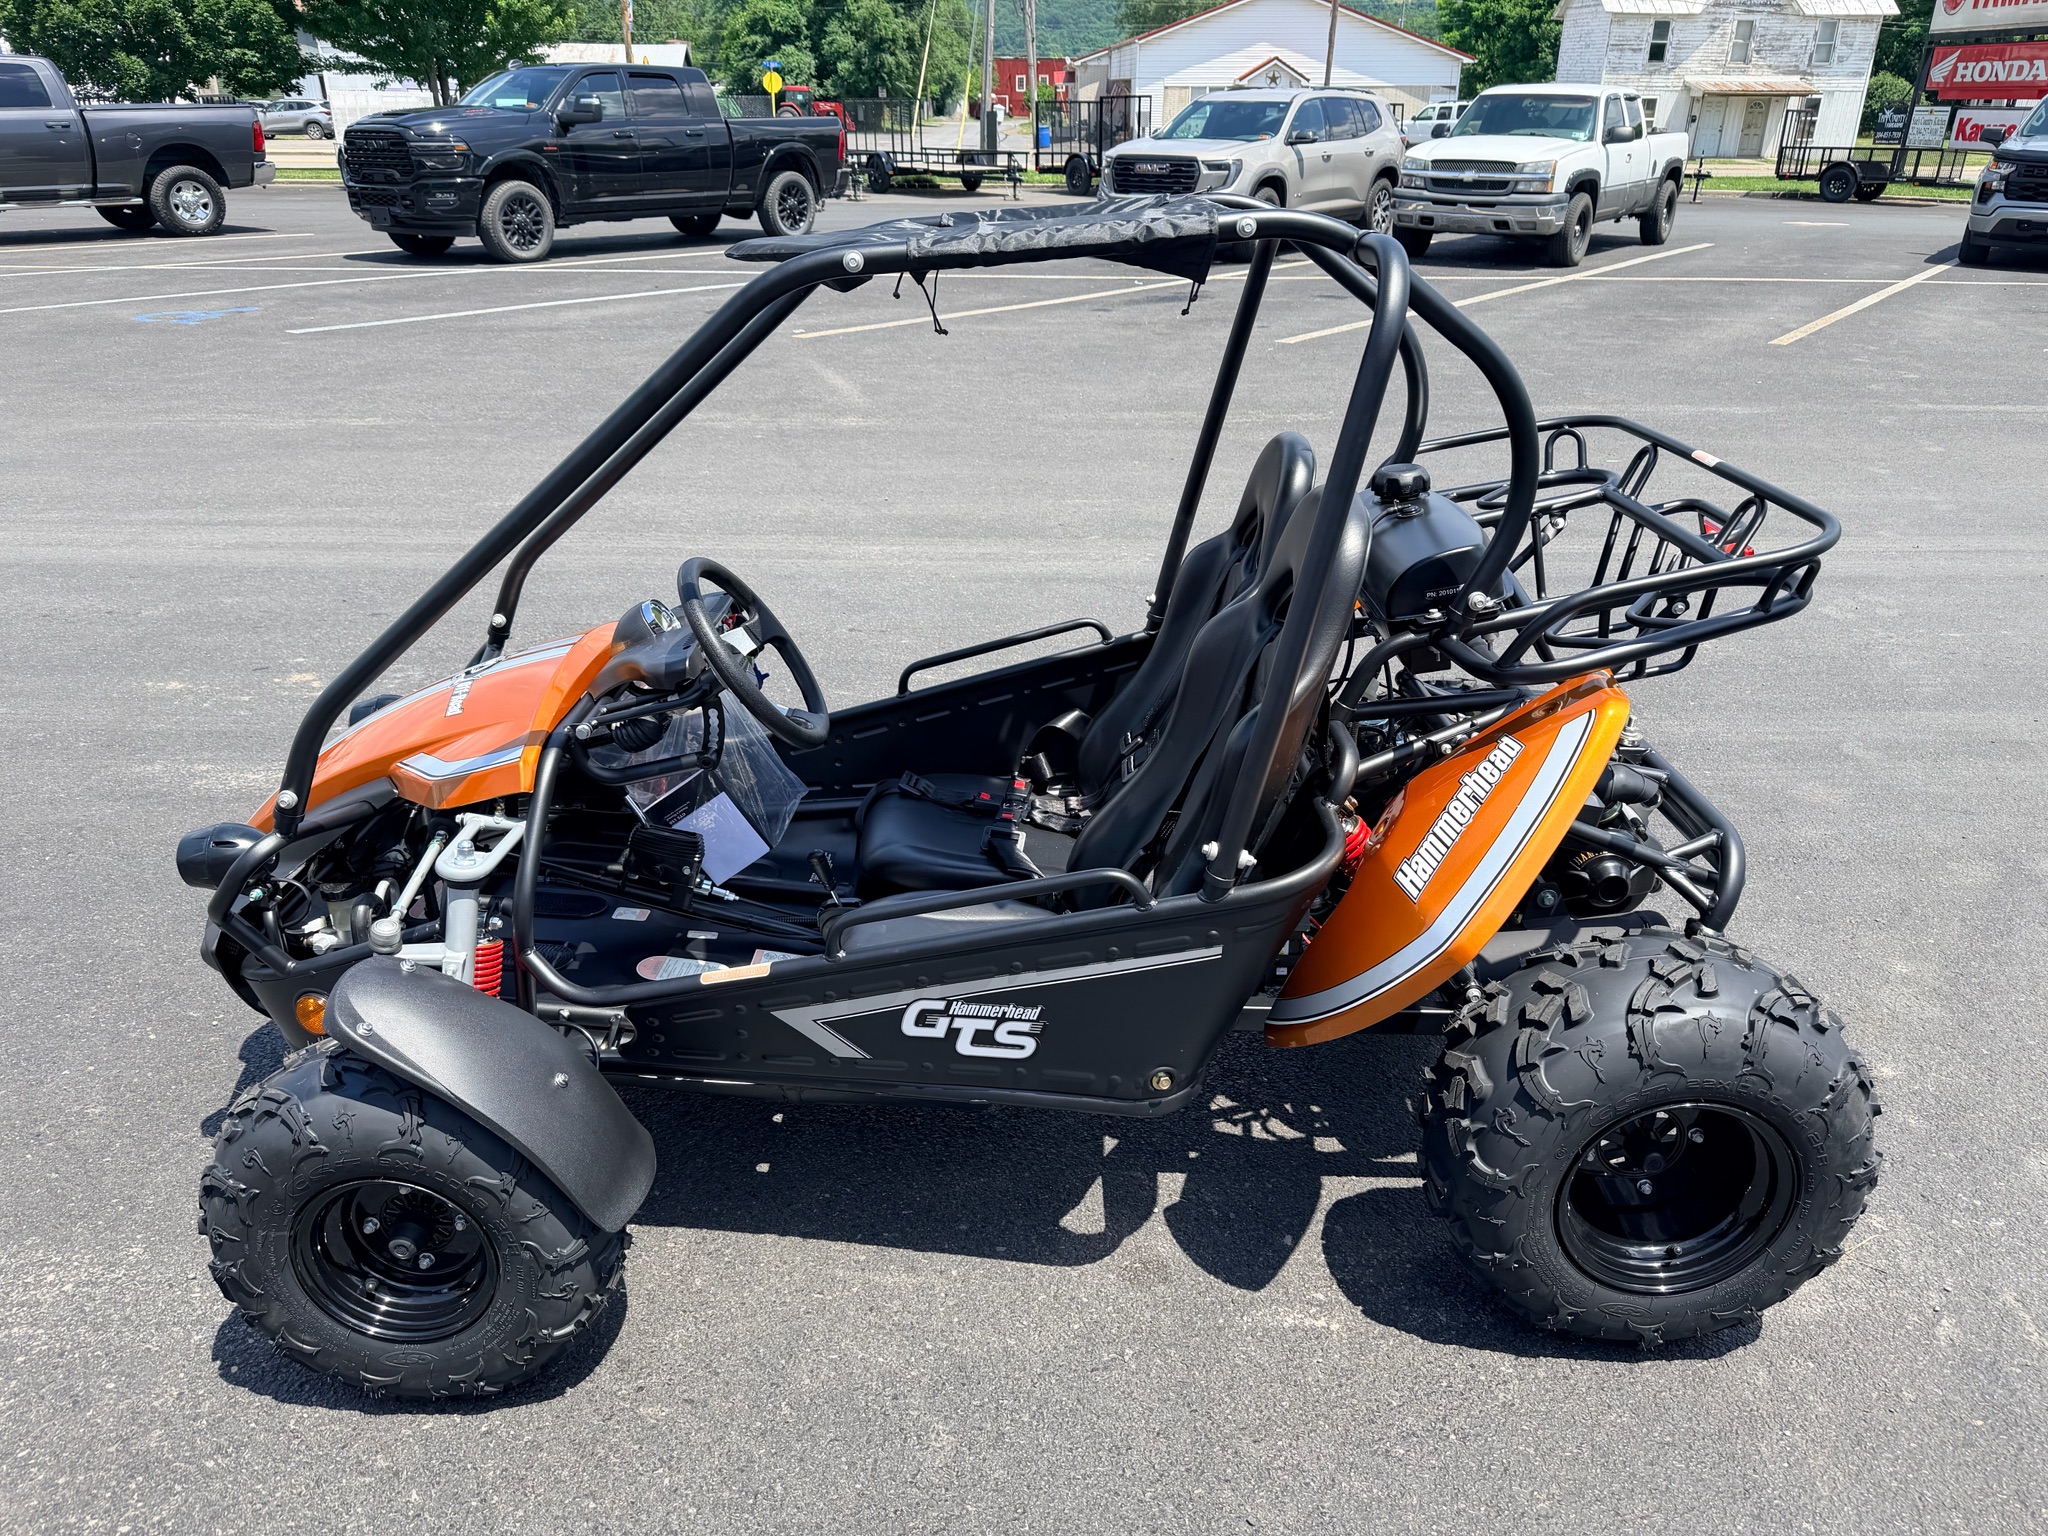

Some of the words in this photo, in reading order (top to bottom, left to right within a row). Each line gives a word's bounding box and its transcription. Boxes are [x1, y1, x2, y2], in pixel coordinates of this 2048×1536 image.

[1953, 60, 2048, 82] HONDA
[1135, 163, 1170, 174] GMC
[1393, 734, 1525, 902] Hammerhead
[948, 1001, 1041, 1020] Hammerhead
[900, 999, 1045, 1060] GTS
